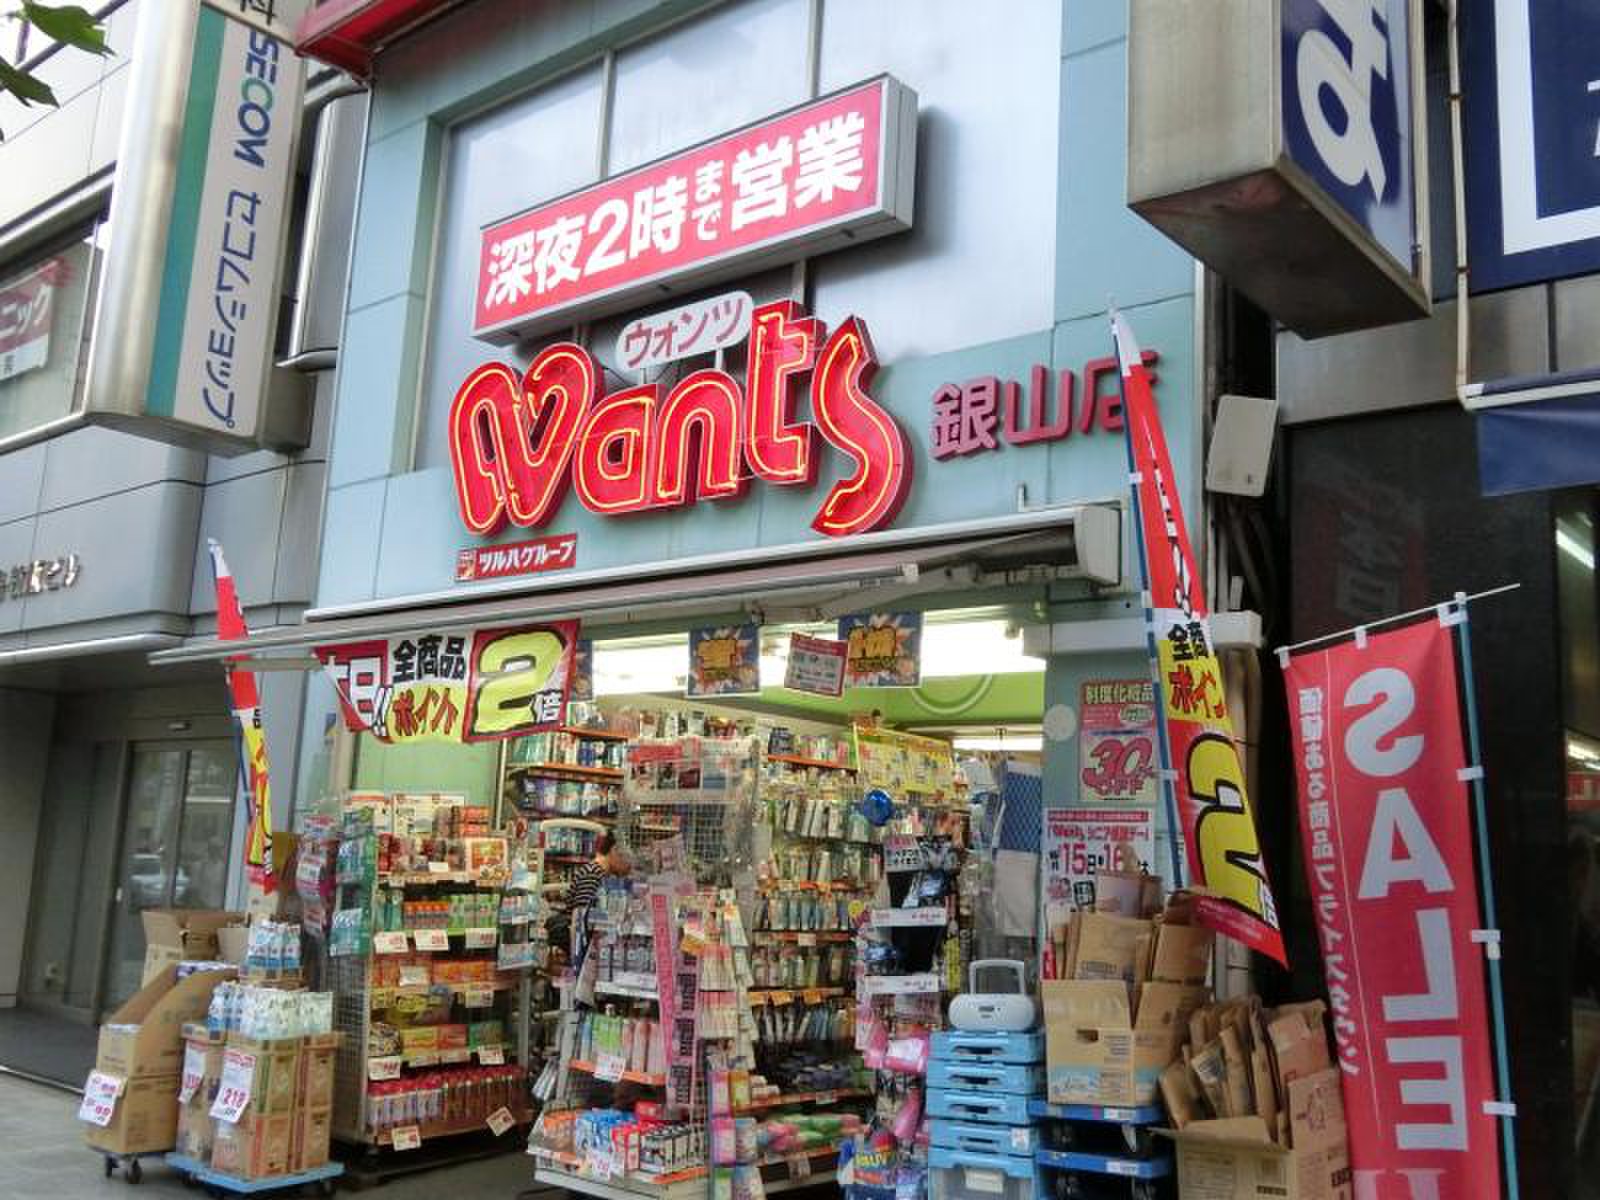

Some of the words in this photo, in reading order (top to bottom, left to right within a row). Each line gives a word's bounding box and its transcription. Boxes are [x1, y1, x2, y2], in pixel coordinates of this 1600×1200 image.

[233, 32, 279, 168] SECOM
[484, 111, 865, 308] 深夜2時まで営業
[202, 190, 262, 429] セコムショップ
[448, 300, 913, 537] Wants
[479, 540, 576, 574] ツルハグループ
[391, 633, 466, 684] 全商品
